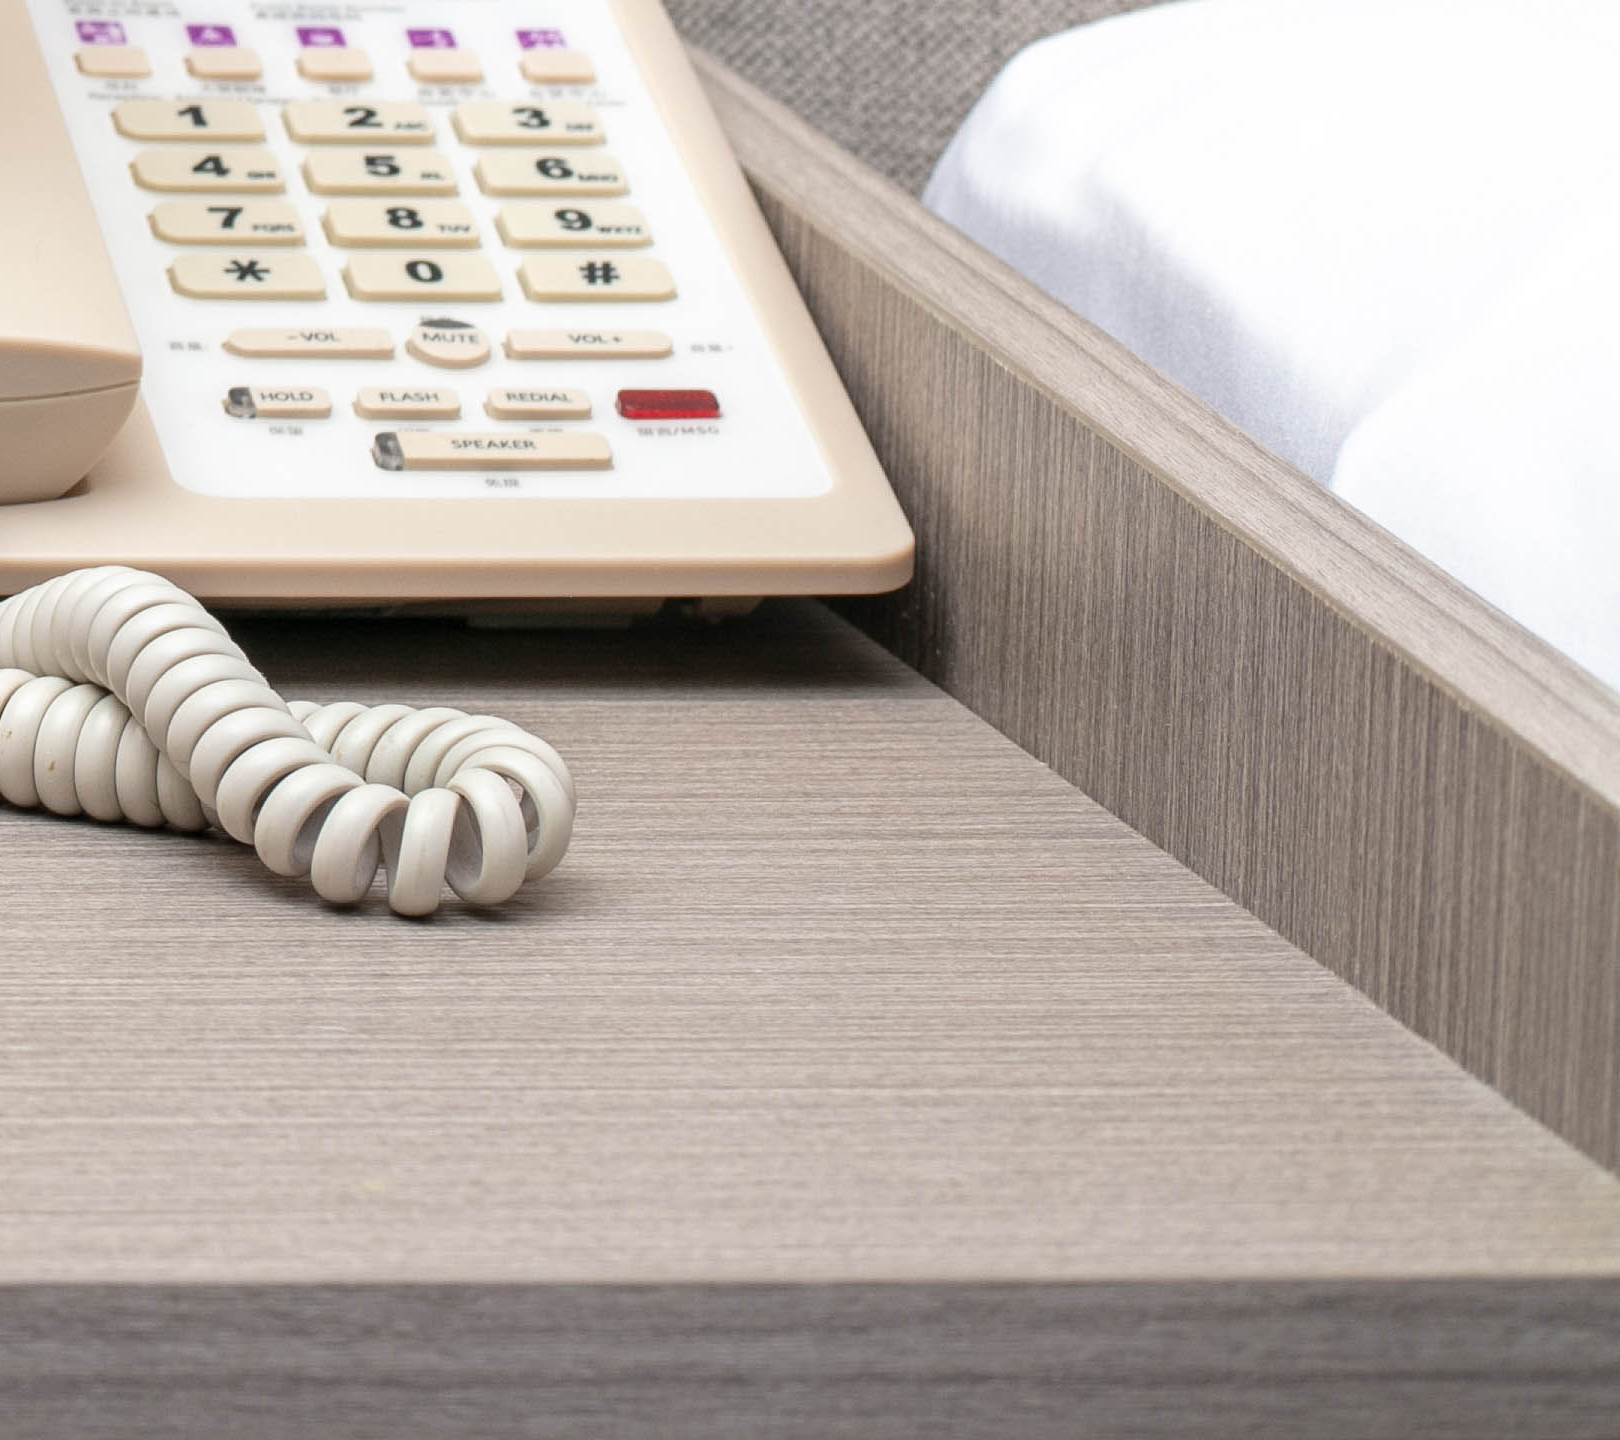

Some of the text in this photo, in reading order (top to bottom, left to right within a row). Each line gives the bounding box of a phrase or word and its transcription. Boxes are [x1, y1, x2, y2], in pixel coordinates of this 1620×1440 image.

[177, 104, 208, 127] 1
[343, 107, 383, 128] 2
[513, 107, 551, 129] 3
[192, 155, 231, 177] 4
[364, 155, 401, 177] 5
[535, 157, 574, 180] 6
[207, 206, 243, 229] 7
[385, 207, 424, 230] 8
[554, 209, 593, 232] 9
[404, 260, 444, 283] 0
[421, 332, 480, 345] MUTE
[259, 391, 314, 402] HOLD
[379, 392, 439, 402] FLASH
[505, 392, 572, 403] REDIAL
[451, 439, 537, 449] SPEAKER
